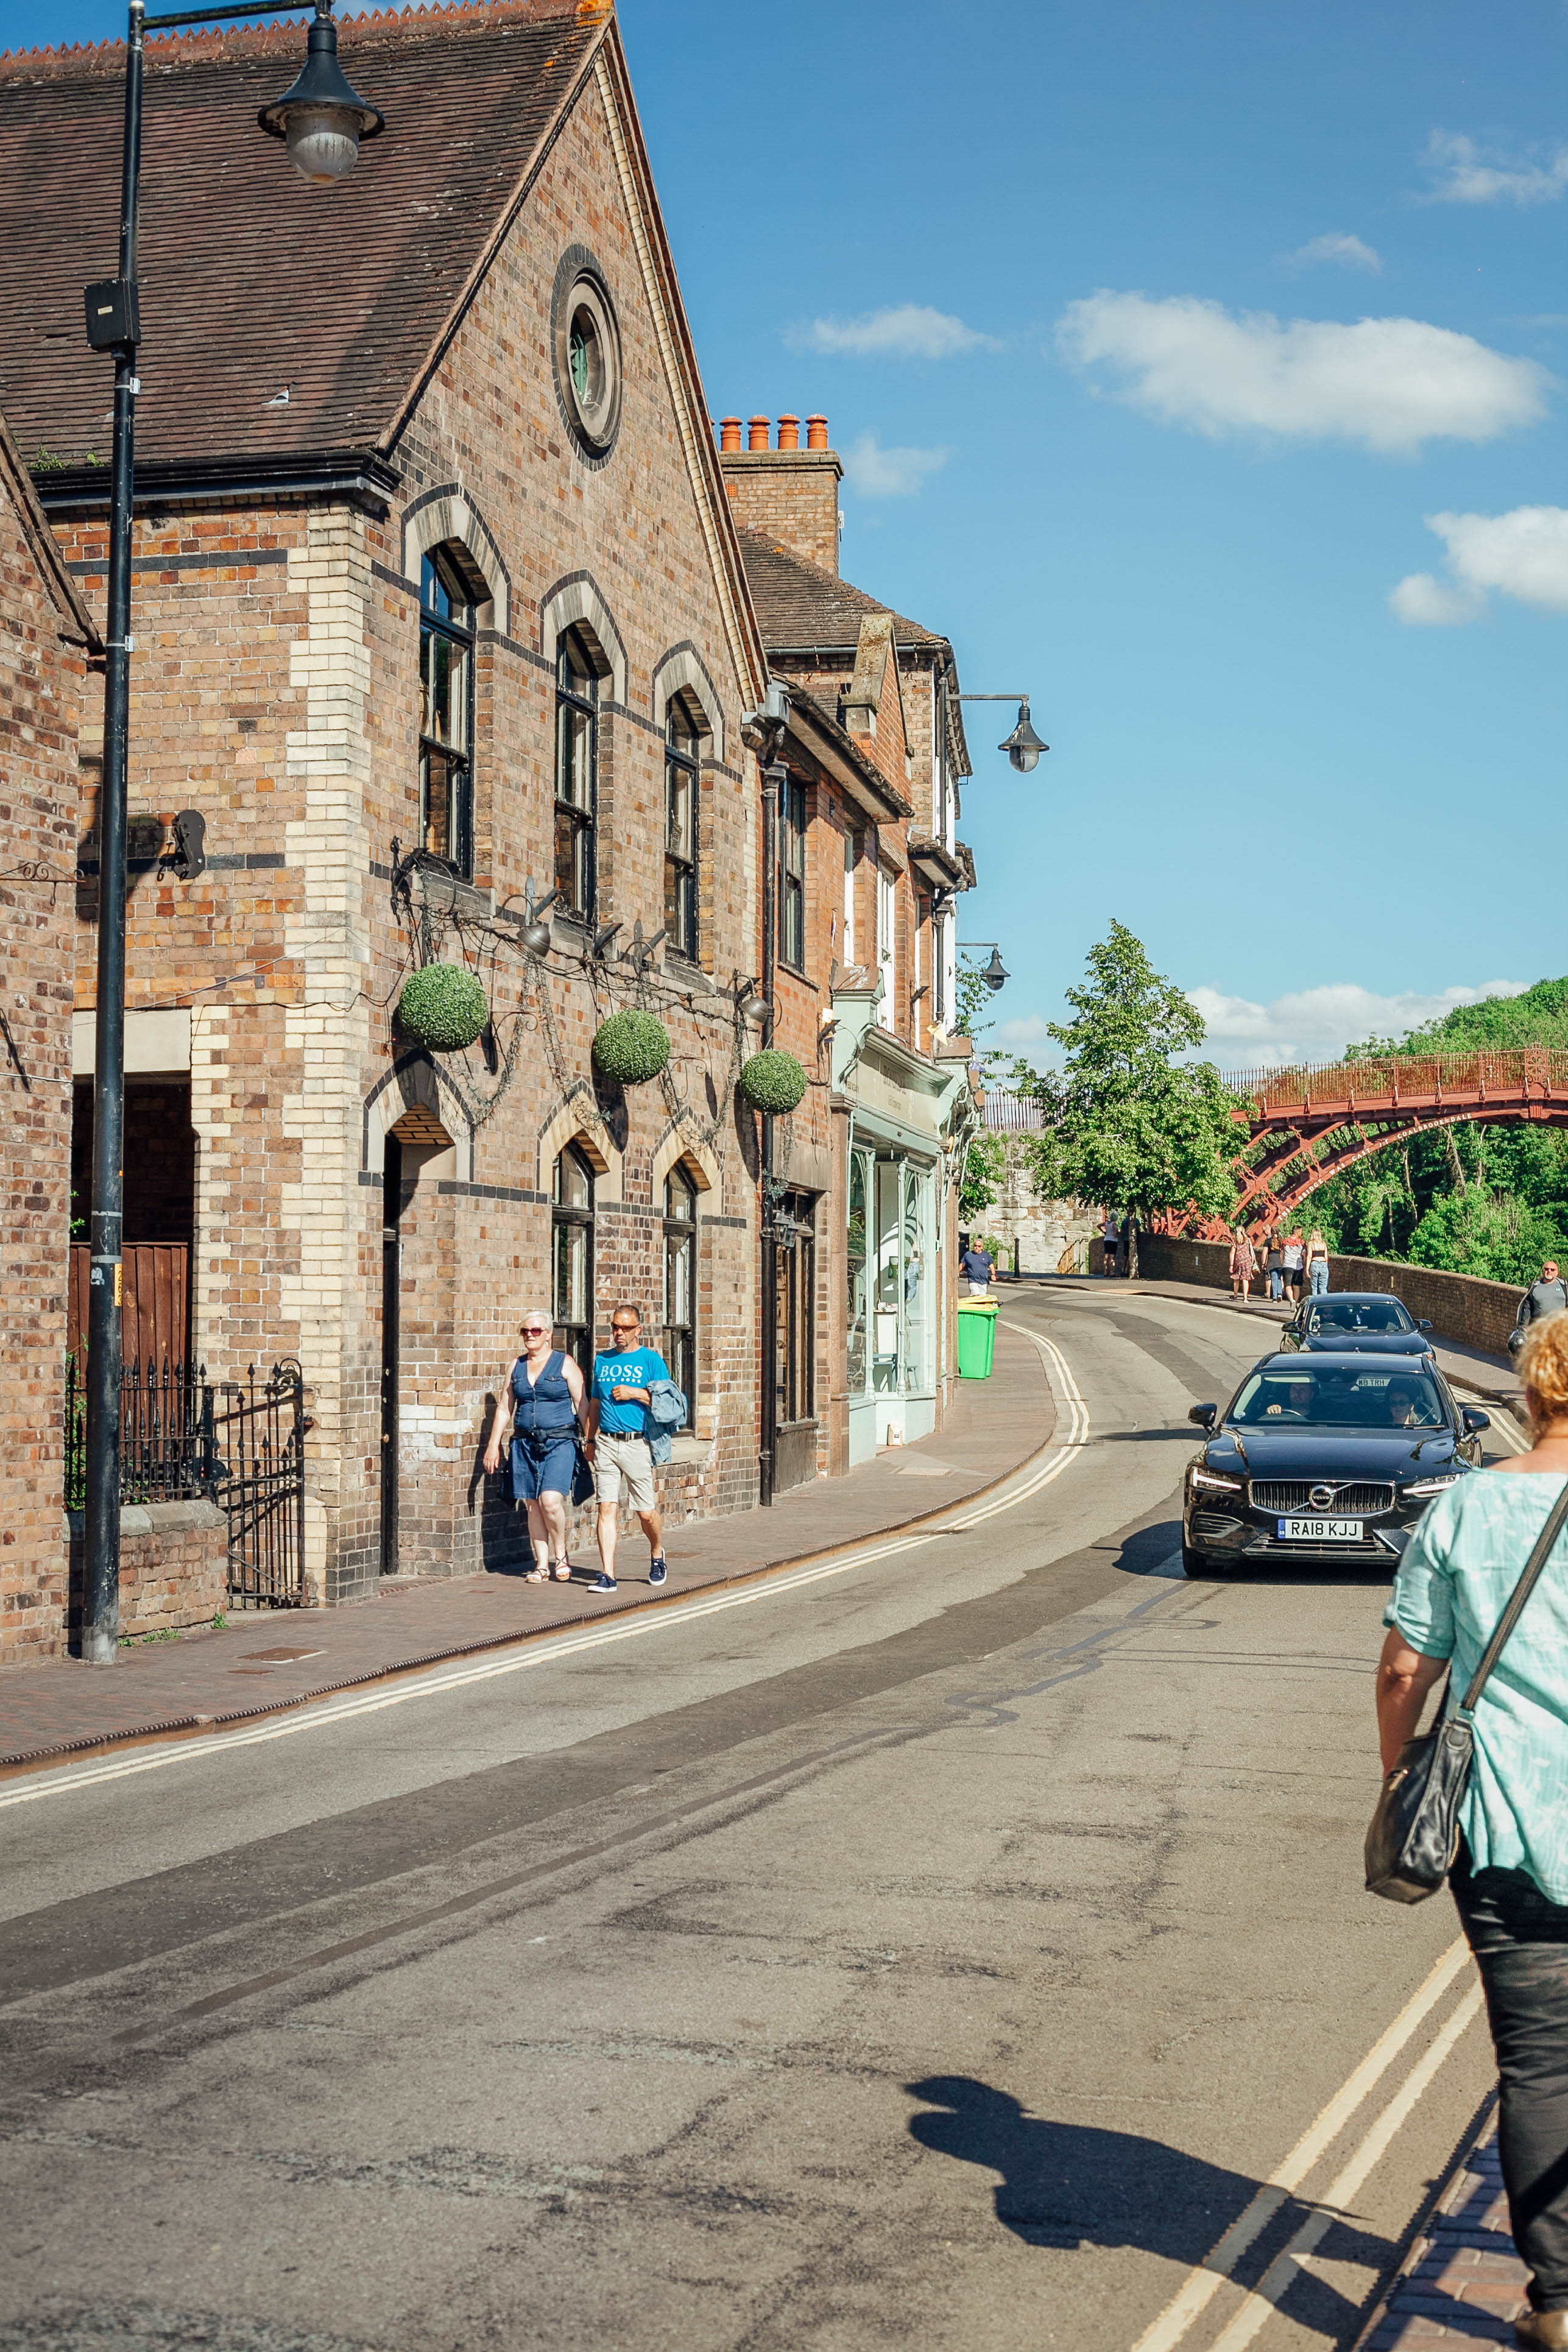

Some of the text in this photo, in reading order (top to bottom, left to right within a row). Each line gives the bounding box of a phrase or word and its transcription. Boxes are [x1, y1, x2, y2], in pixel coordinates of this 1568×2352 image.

[1277, 1205, 1294, 1221] THIS
[1298, 1179, 1323, 1201] BRIDGE
[1329, 1162, 1346, 1176] WAS
[1352, 1147, 1371, 1162] CAST
[599, 1365, 643, 1379] BOSS
[1291, 1522, 1357, 1536] RA18 KJJ
